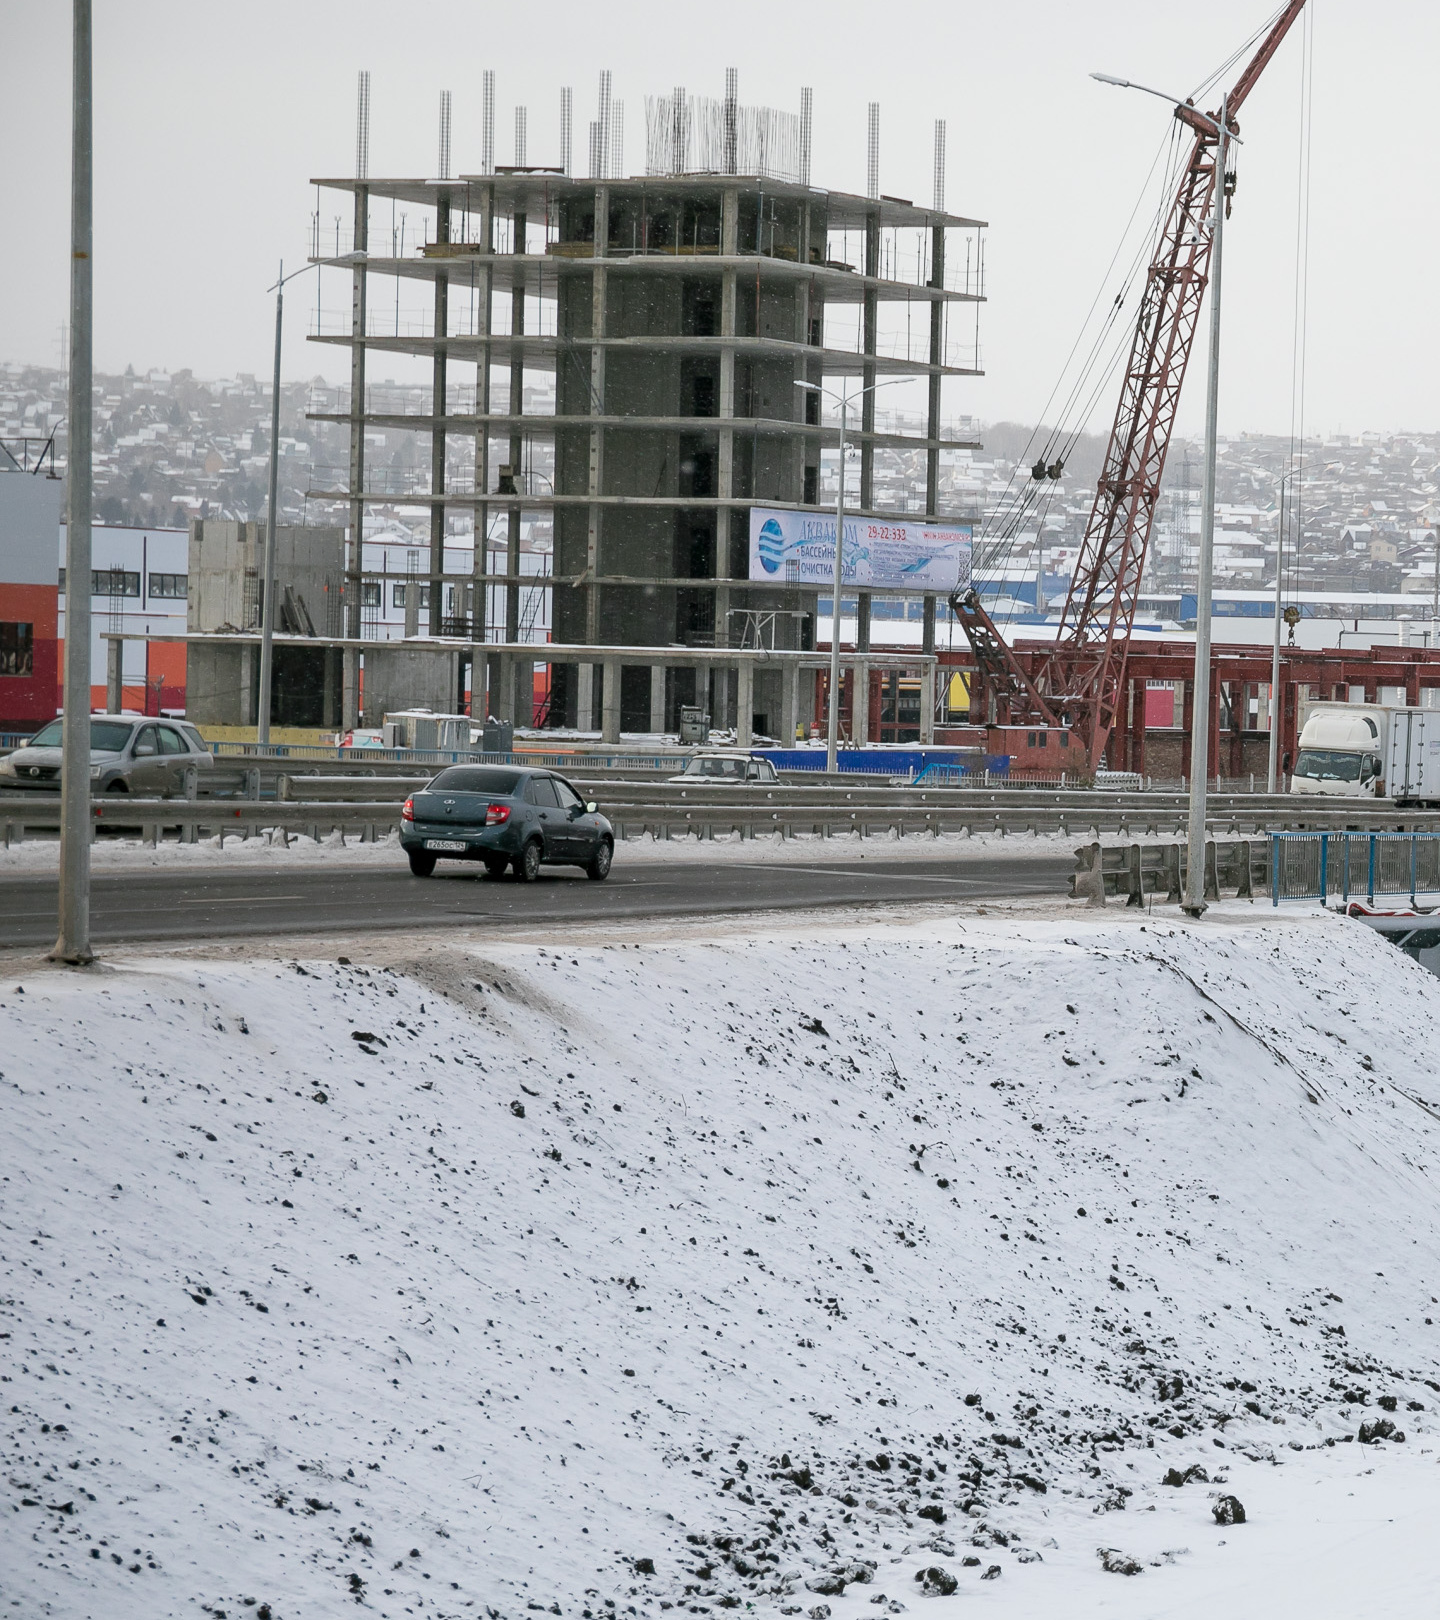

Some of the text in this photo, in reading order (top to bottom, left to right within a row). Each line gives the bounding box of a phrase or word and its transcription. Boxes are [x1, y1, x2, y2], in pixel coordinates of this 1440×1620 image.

[867, 525, 907, 541] 29-22-333
[800, 562, 834, 576] ОЧИСТКА
[837, 564, 857, 577] ОДЫ
